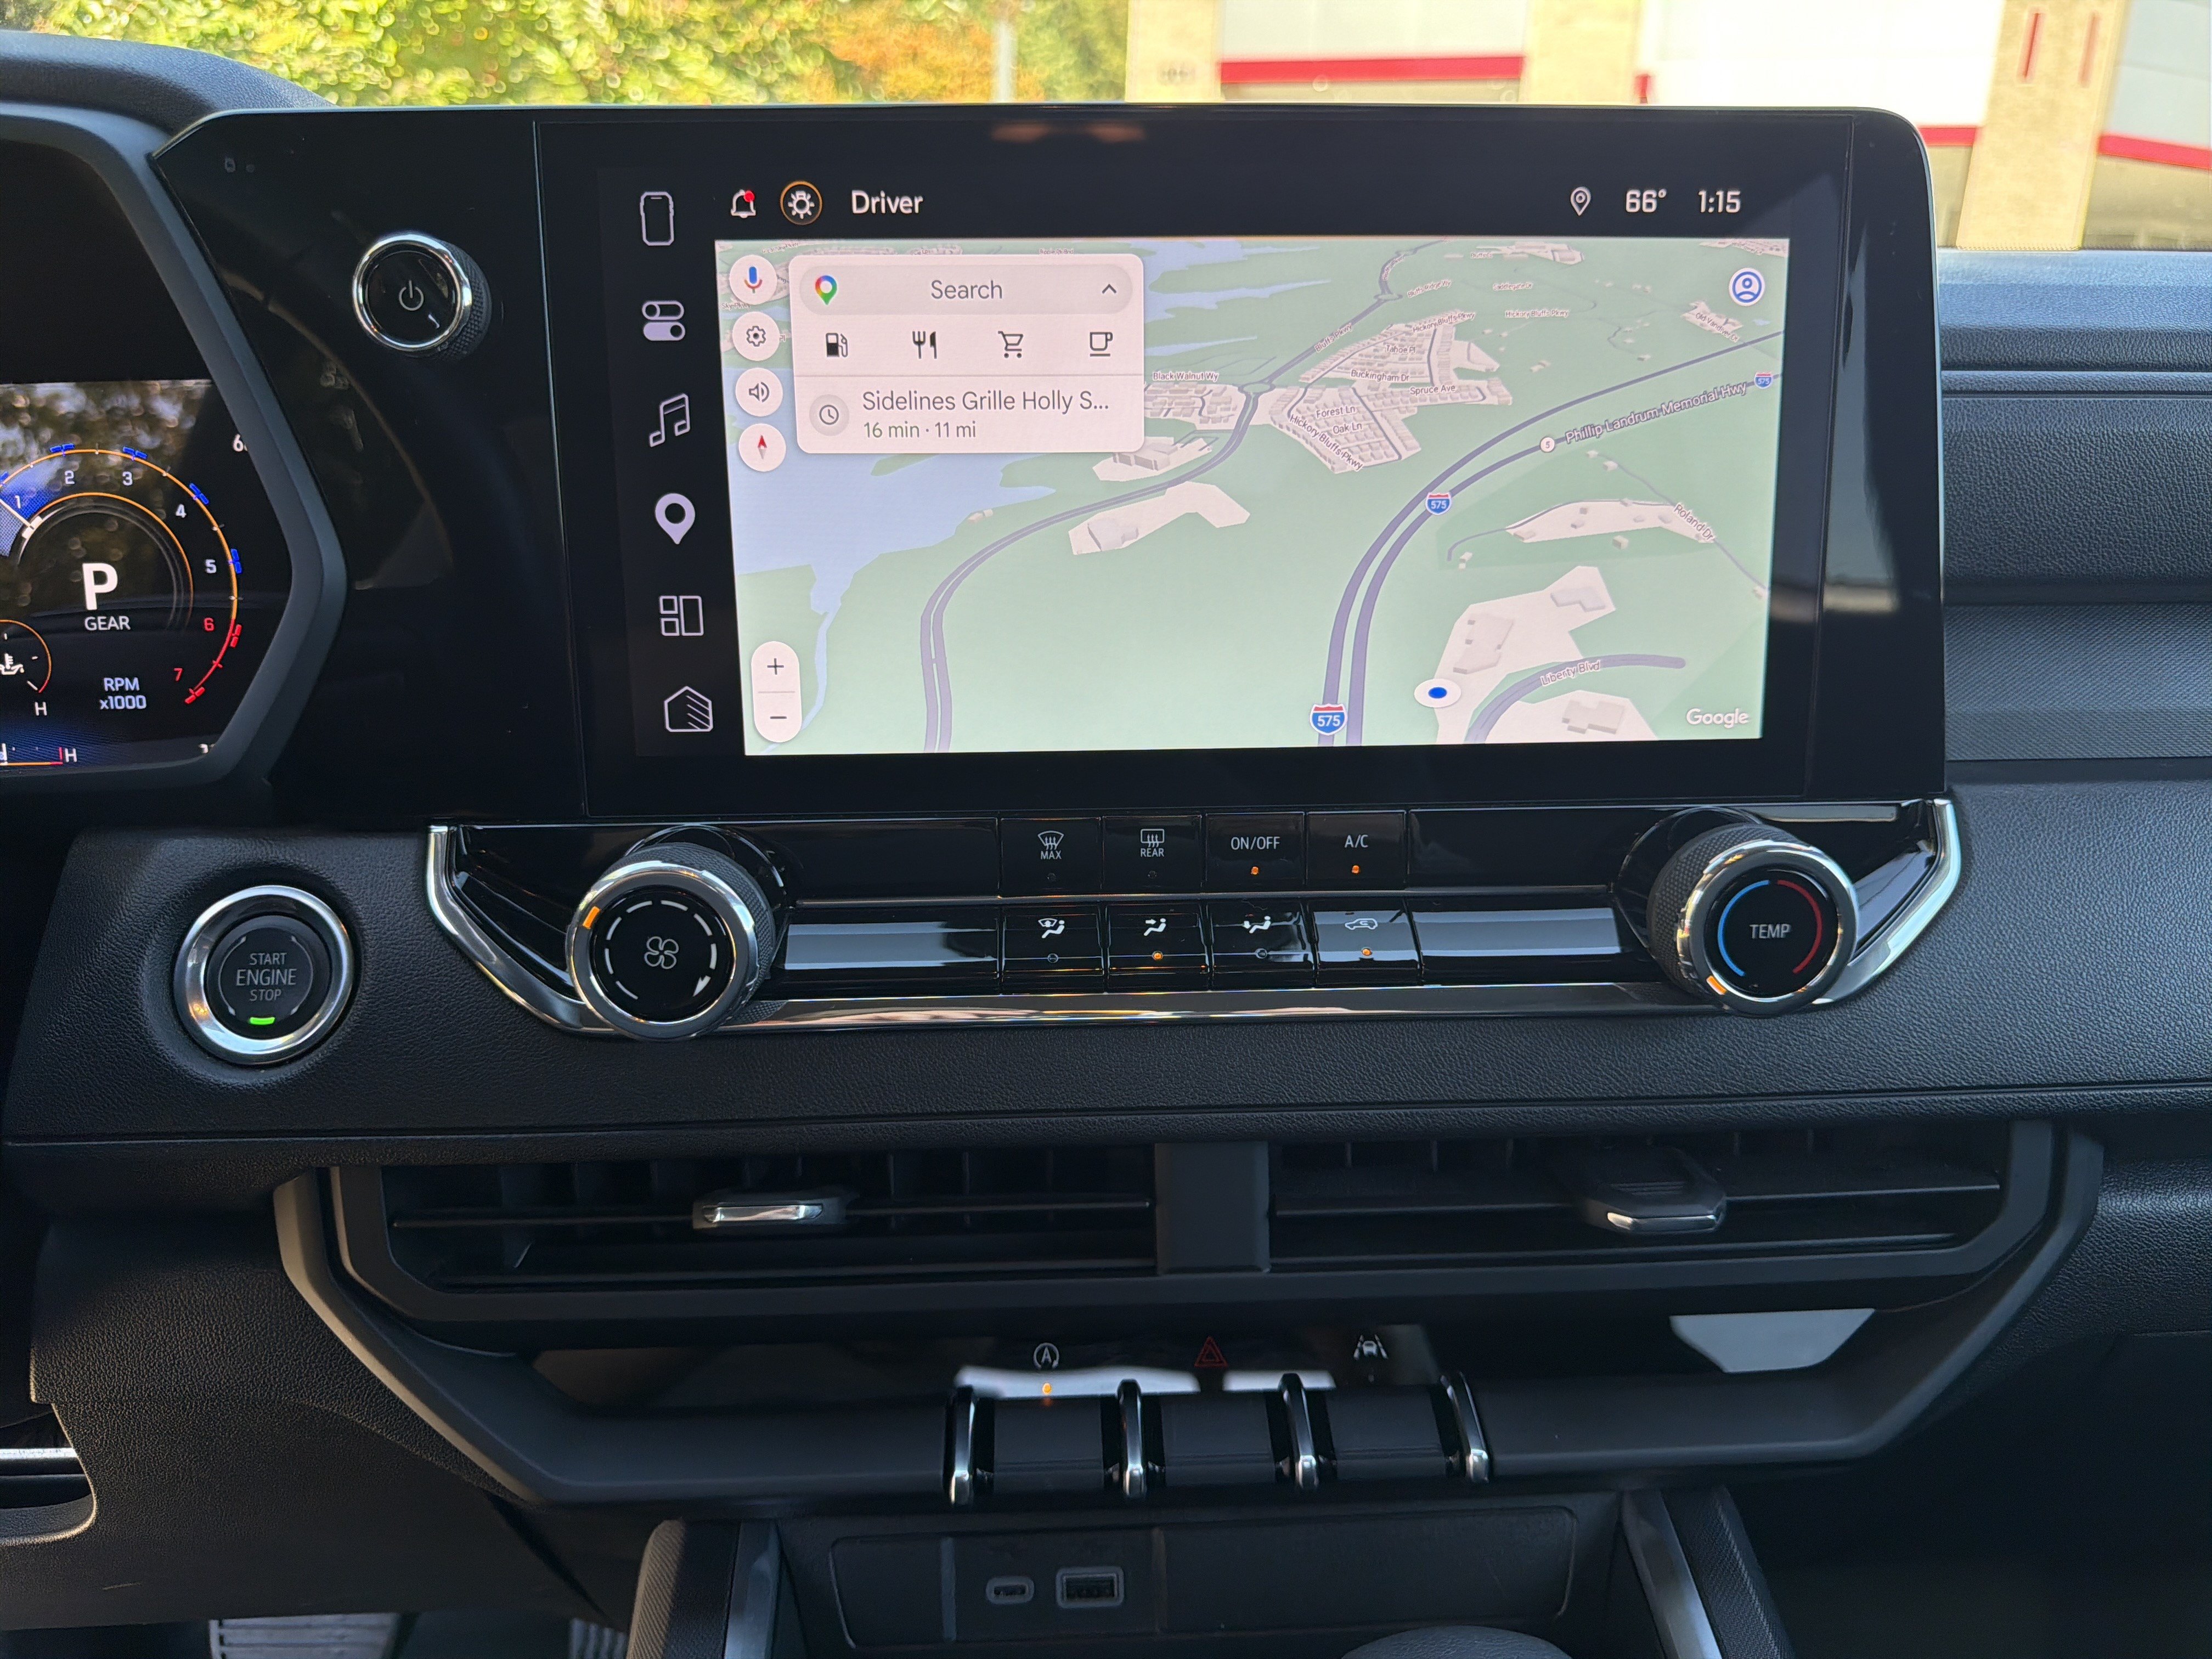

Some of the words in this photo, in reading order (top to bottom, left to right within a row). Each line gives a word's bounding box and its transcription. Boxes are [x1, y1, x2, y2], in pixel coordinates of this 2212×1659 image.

[851, 190, 923, 215] Driver
[1626, 189, 1666, 212] 66°
[1699, 190, 1740, 213] 1:15
[931, 279, 1003, 300] Search
[1412, 321, 1437, 333] Hickory
[1437, 315, 1457, 326] Bluffs
[1457, 311, 1475, 320] Pkwy
[1696, 312, 1706, 322] Old
[1706, 317, 1731, 338] Vandiver
[1314, 336, 1335, 352] Bluffs
[1333, 323, 1352, 339] Pkwy
[1386, 345, 1407, 353] Tahoe
[1153, 371, 1173, 380] Black
[1176, 371, 1204, 380] Walnut
[1206, 372, 1219, 382] Wy
[1351, 369, 1399, 382] Buckingham
[1410, 386, 1438, 396] Spruce
[862, 390, 956, 410] Sidelines
[962, 390, 1015, 410] Grille
[1023, 390, 1073, 415] Holly
[1316, 408, 1343, 418] Forest
[1346, 405, 1355, 414] Ln
[1565, 422, 1603, 443] Phillip
[1605, 408, 1660, 432] Landrum
[1661, 388, 1719, 415] Memorial
[1720, 382, 1747, 399] Hwy
[864, 421, 882, 438] 16
[889, 420, 919, 438] min
[934, 421, 949, 438] 11
[956, 420, 976, 438] mi
[1333, 424, 1350, 433] Oak
[1352, 422, 1362, 431] Ln
[1289, 414, 1320, 438] Hickory
[1319, 433, 1342, 456] Bluffs
[1341, 452, 1363, 471] Pkwy
[64, 470, 75, 484] 2
[122, 471, 133, 486] 3
[175, 504, 187, 518] 4
[1431, 500, 1447, 509] 575
[1673, 504, 1705, 532] Roland
[1702, 528, 1713, 540] Dr
[205, 559, 217, 574] 5
[82, 563, 118, 611] P
[84, 616, 131, 631] GEAR
[204, 617, 215, 631] 6
[173, 668, 183, 681] 7
[1541, 667, 1576, 685] Liberty
[1578, 660, 1600, 673] Blvd
[104, 677, 140, 692] RPM
[35, 701, 48, 716] H
[100, 695, 146, 710] x1000
[1317, 715, 1340, 727] 575
[1686, 708, 1750, 729] Google
[64, 747, 77, 763] H
[1231, 836, 1280, 851] ON/OFF
[1344, 834, 1369, 849] A/C
[1040, 850, 1062, 860] MAX
[1140, 848, 1165, 857] REAR
[1749, 924, 1791, 939] TEMP
[249, 952, 287, 966] START
[236, 969, 297, 986] ENGINE
[249, 989, 282, 1001] STOP
